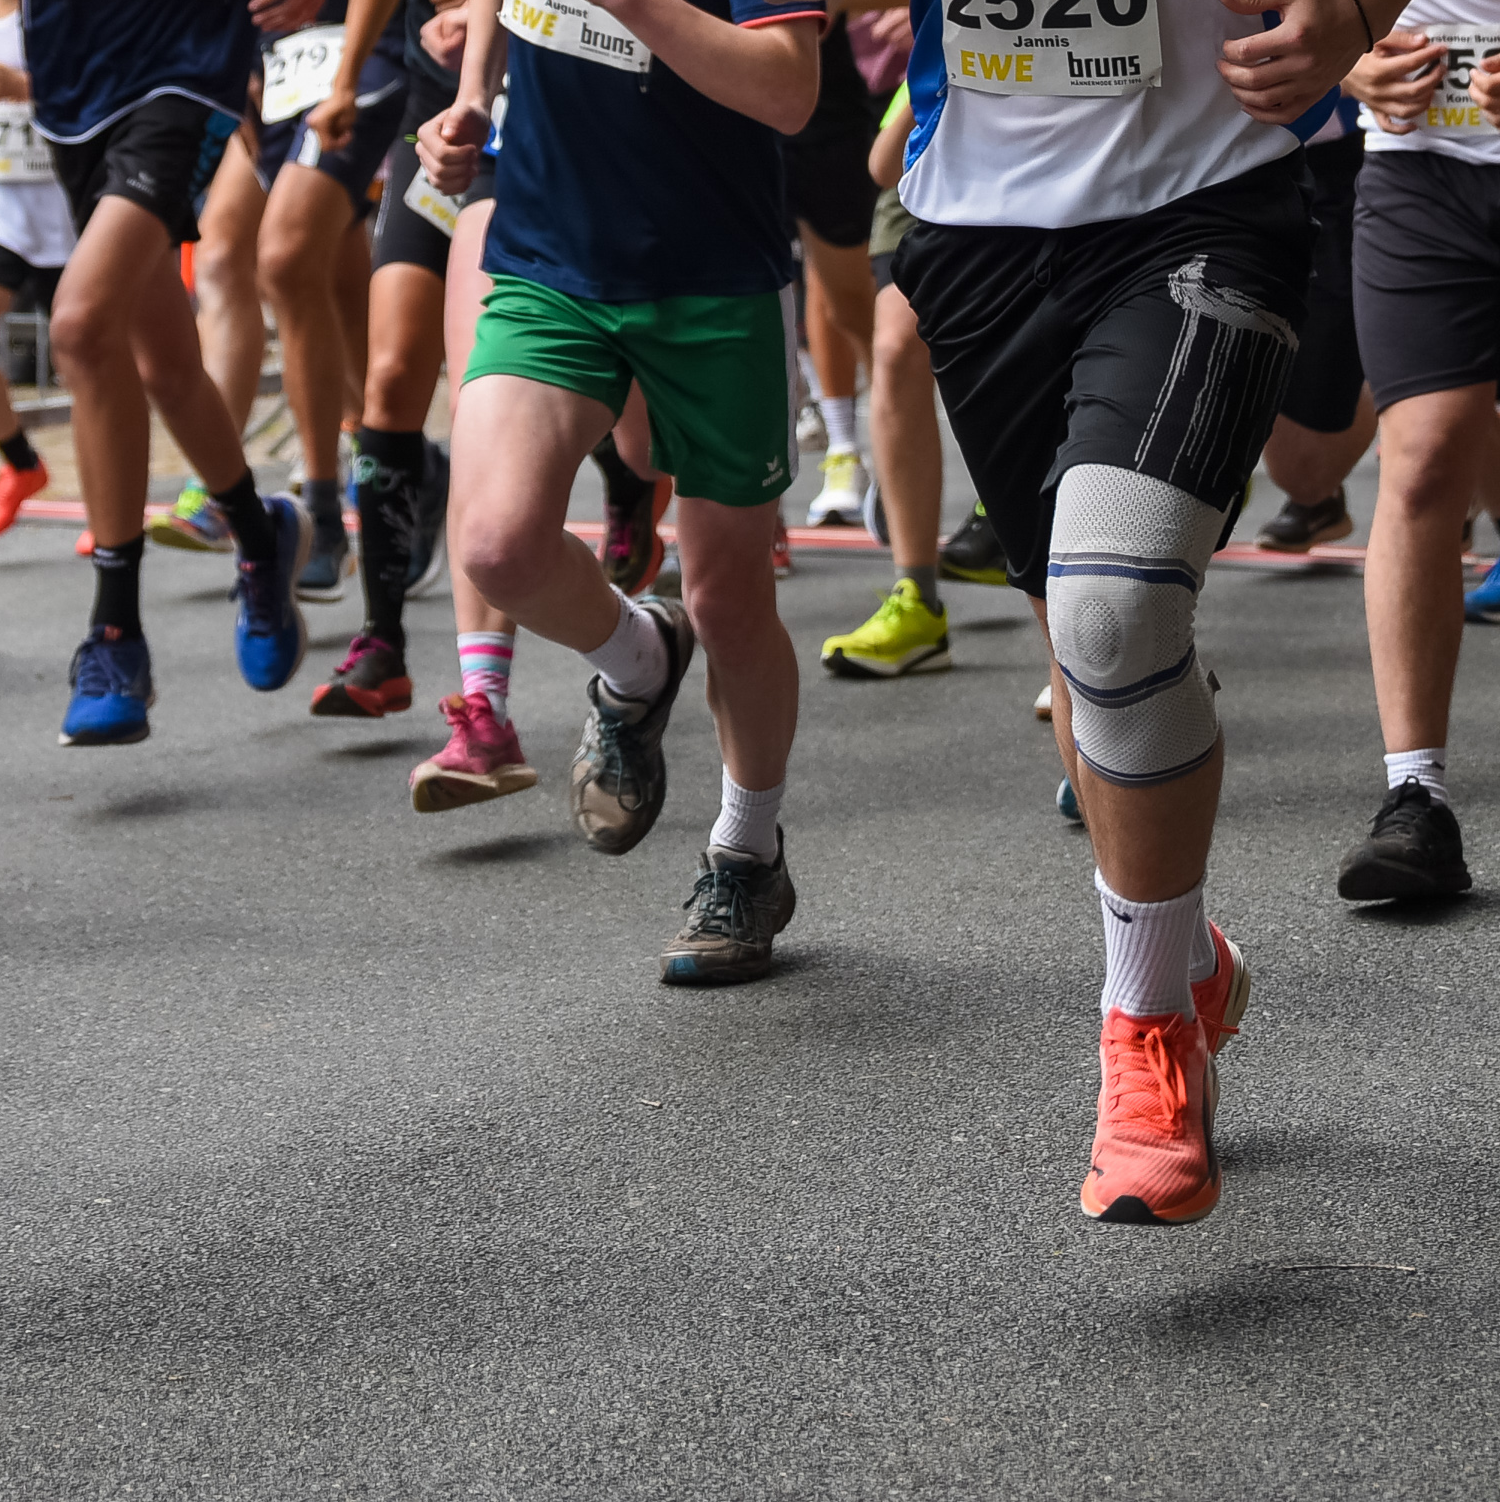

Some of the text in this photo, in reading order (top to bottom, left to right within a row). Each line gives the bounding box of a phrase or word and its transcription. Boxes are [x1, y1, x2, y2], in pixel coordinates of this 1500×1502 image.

[580, 23, 634, 56] bruns
[1013, 35, 1070, 48] Jannis
[961, 50, 1034, 82] EWE
[1067, 51, 1141, 78] bruns
[1427, 107, 1480, 126] EWE
